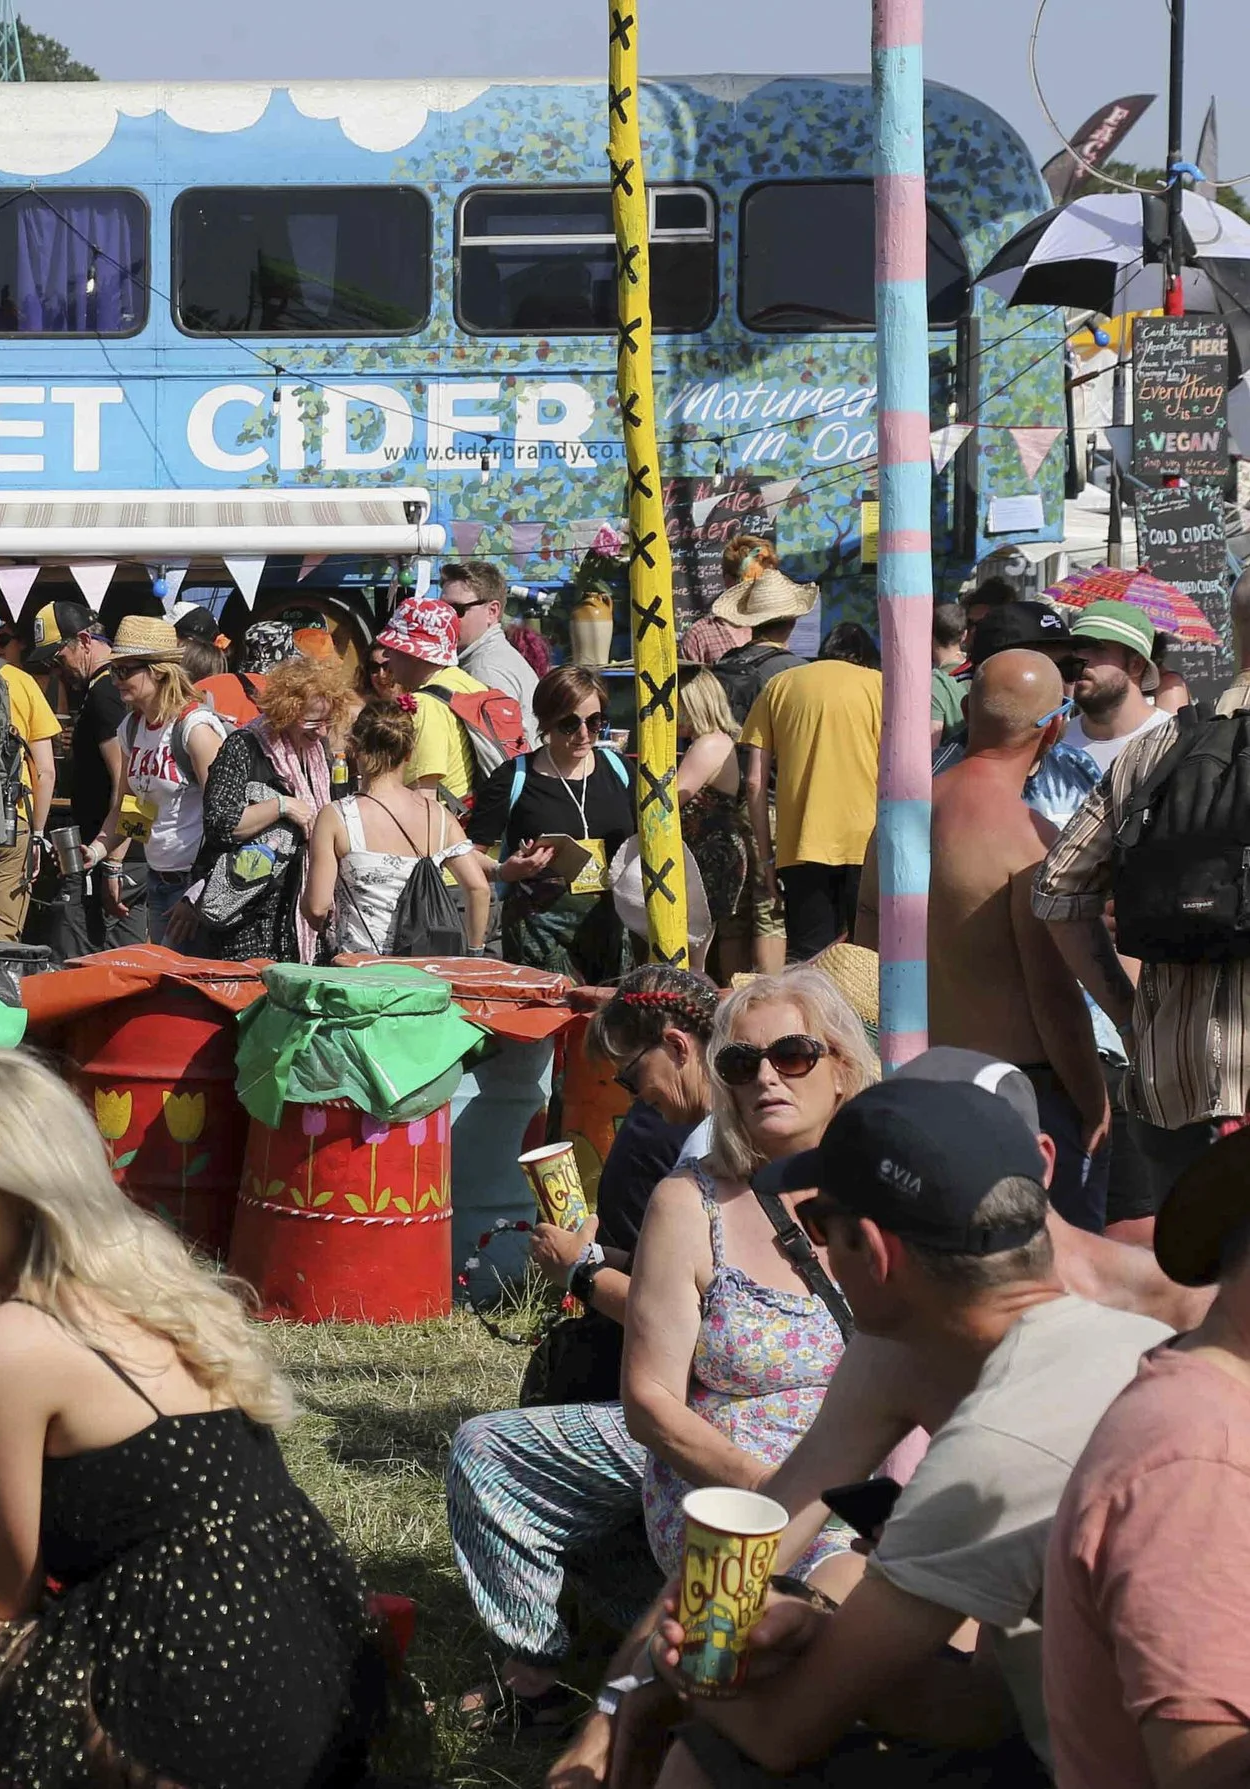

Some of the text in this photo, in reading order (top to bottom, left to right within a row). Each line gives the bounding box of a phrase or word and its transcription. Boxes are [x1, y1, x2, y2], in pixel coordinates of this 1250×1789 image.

[1191, 338, 1229, 357] HERE
[1138, 373, 1224, 416] Everything
[186, 383, 598, 473] CIDER
[742, 421, 878, 462] in Oa
[1149, 431, 1221, 453] VEGAN
[1149, 523, 1220, 546] COLD CIDER
[683, 1539, 781, 1617] Cider
